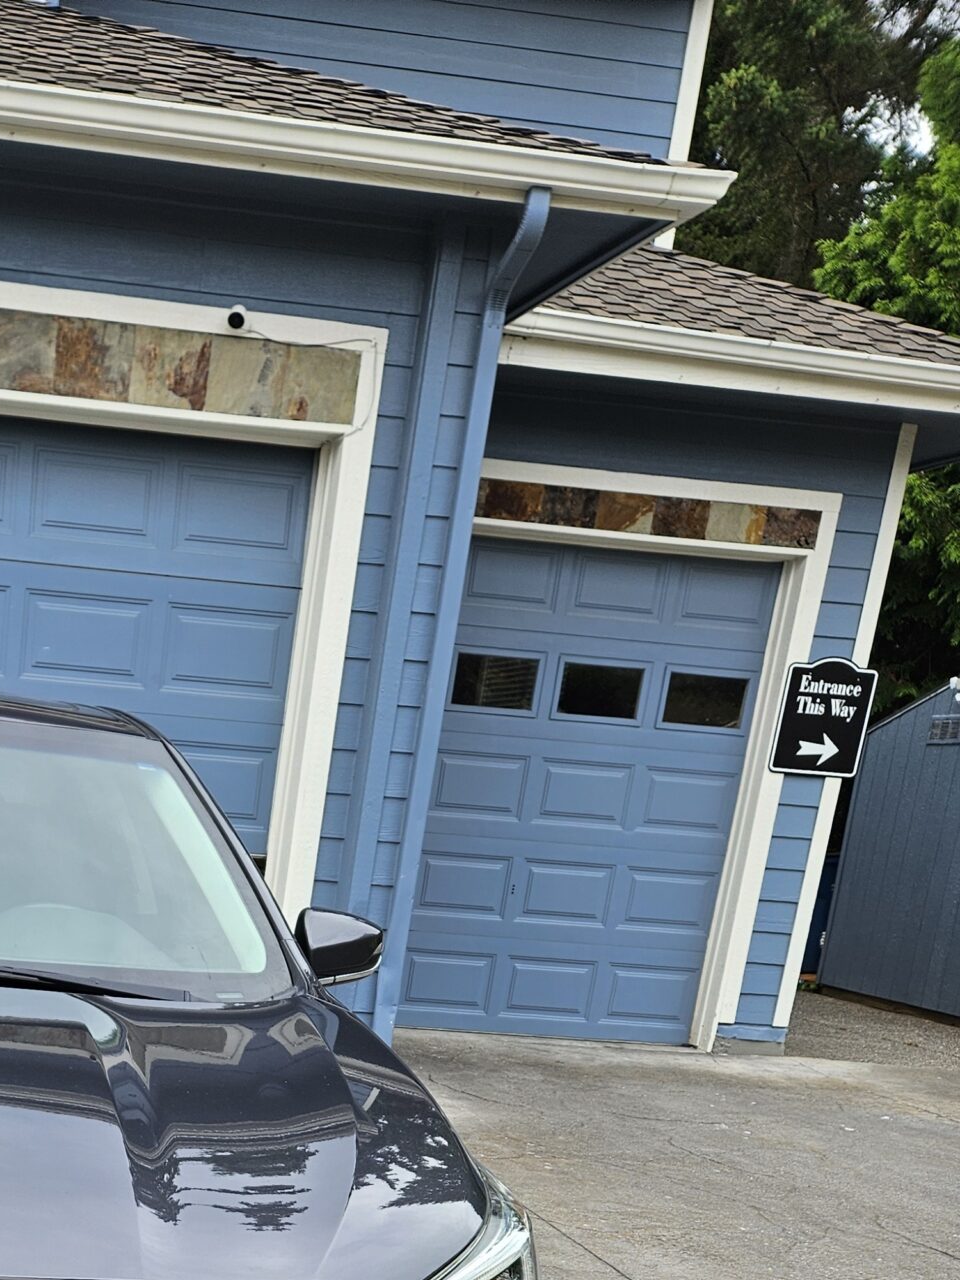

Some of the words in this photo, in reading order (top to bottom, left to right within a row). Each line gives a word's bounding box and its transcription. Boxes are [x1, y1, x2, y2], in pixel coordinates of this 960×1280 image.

[798, 673, 862, 697] Entrance
[796, 696, 826, 716] This
[830, 698, 858, 723] Way
